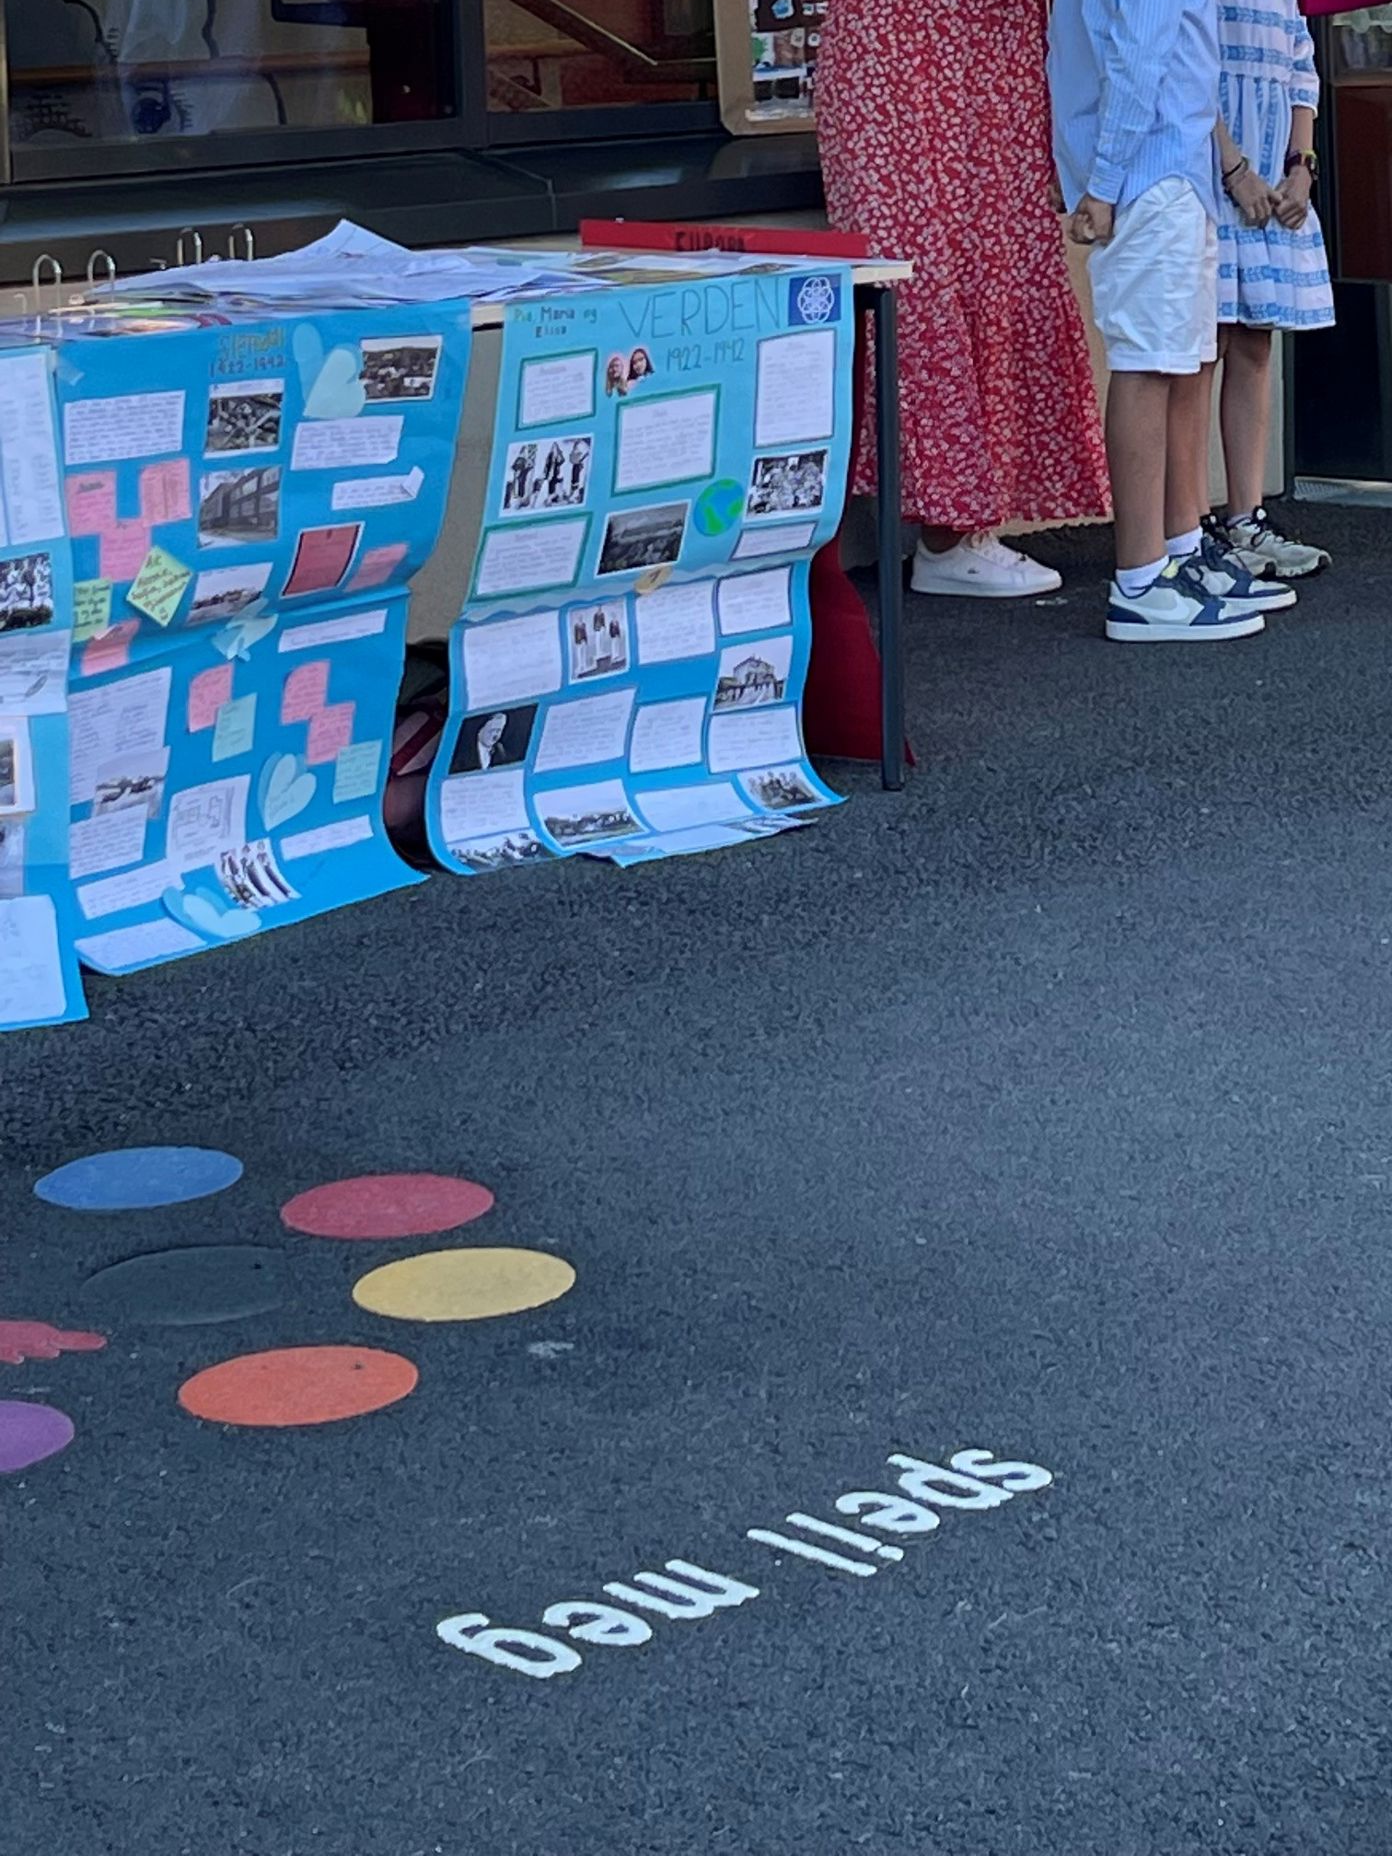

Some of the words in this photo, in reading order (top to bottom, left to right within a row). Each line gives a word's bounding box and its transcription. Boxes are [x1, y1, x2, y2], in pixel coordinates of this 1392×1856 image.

[541, 306, 575, 321] Maria
[618, 276, 780, 339] VERDEN
[666, 337, 745, 373] 1922-1942
[747, 1449, 1054, 1577] speil
[436, 1559, 760, 1679] meg
